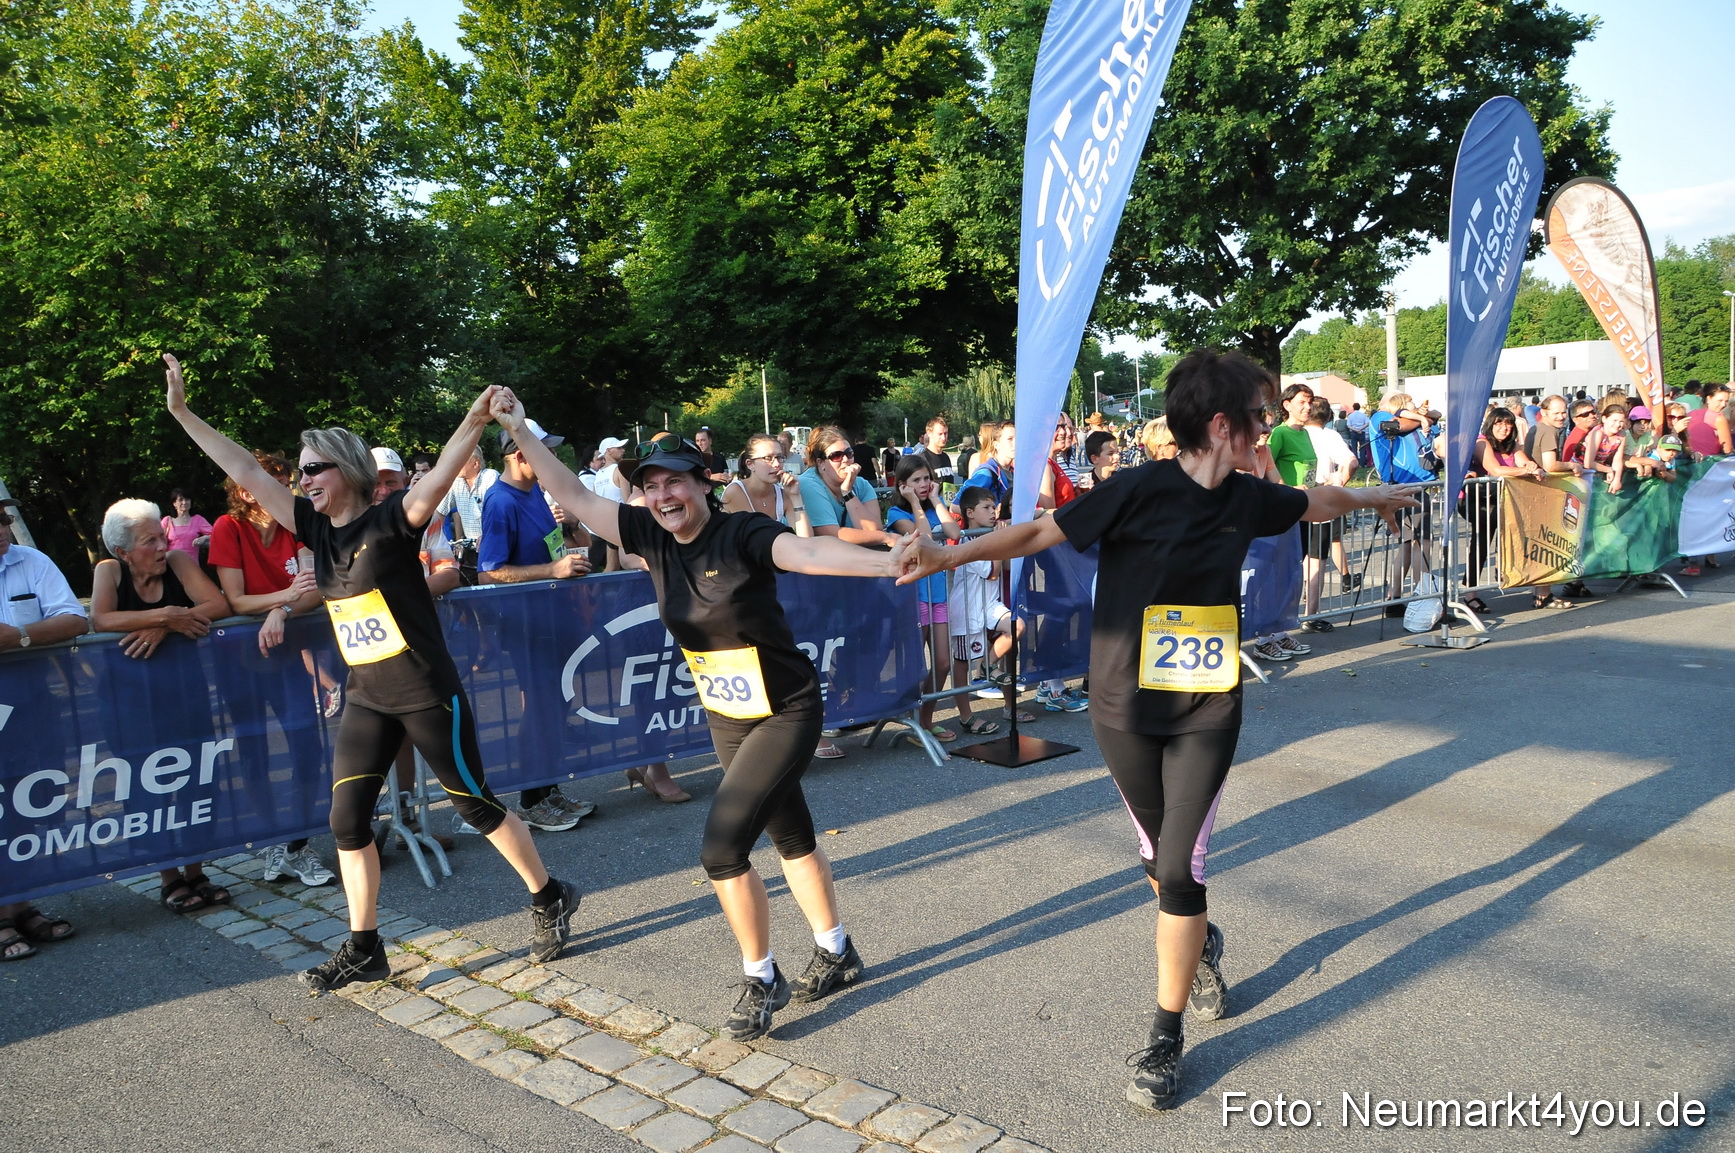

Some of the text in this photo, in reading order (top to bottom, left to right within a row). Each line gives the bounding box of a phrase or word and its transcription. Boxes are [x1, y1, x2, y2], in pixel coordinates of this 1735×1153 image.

[1473, 135, 1525, 295] Fischer
[1495, 165, 1530, 293] AUTOMOBILE
[339, 617, 388, 649] 248
[1154, 635, 1224, 671] 238
[699, 674, 752, 702] 239
